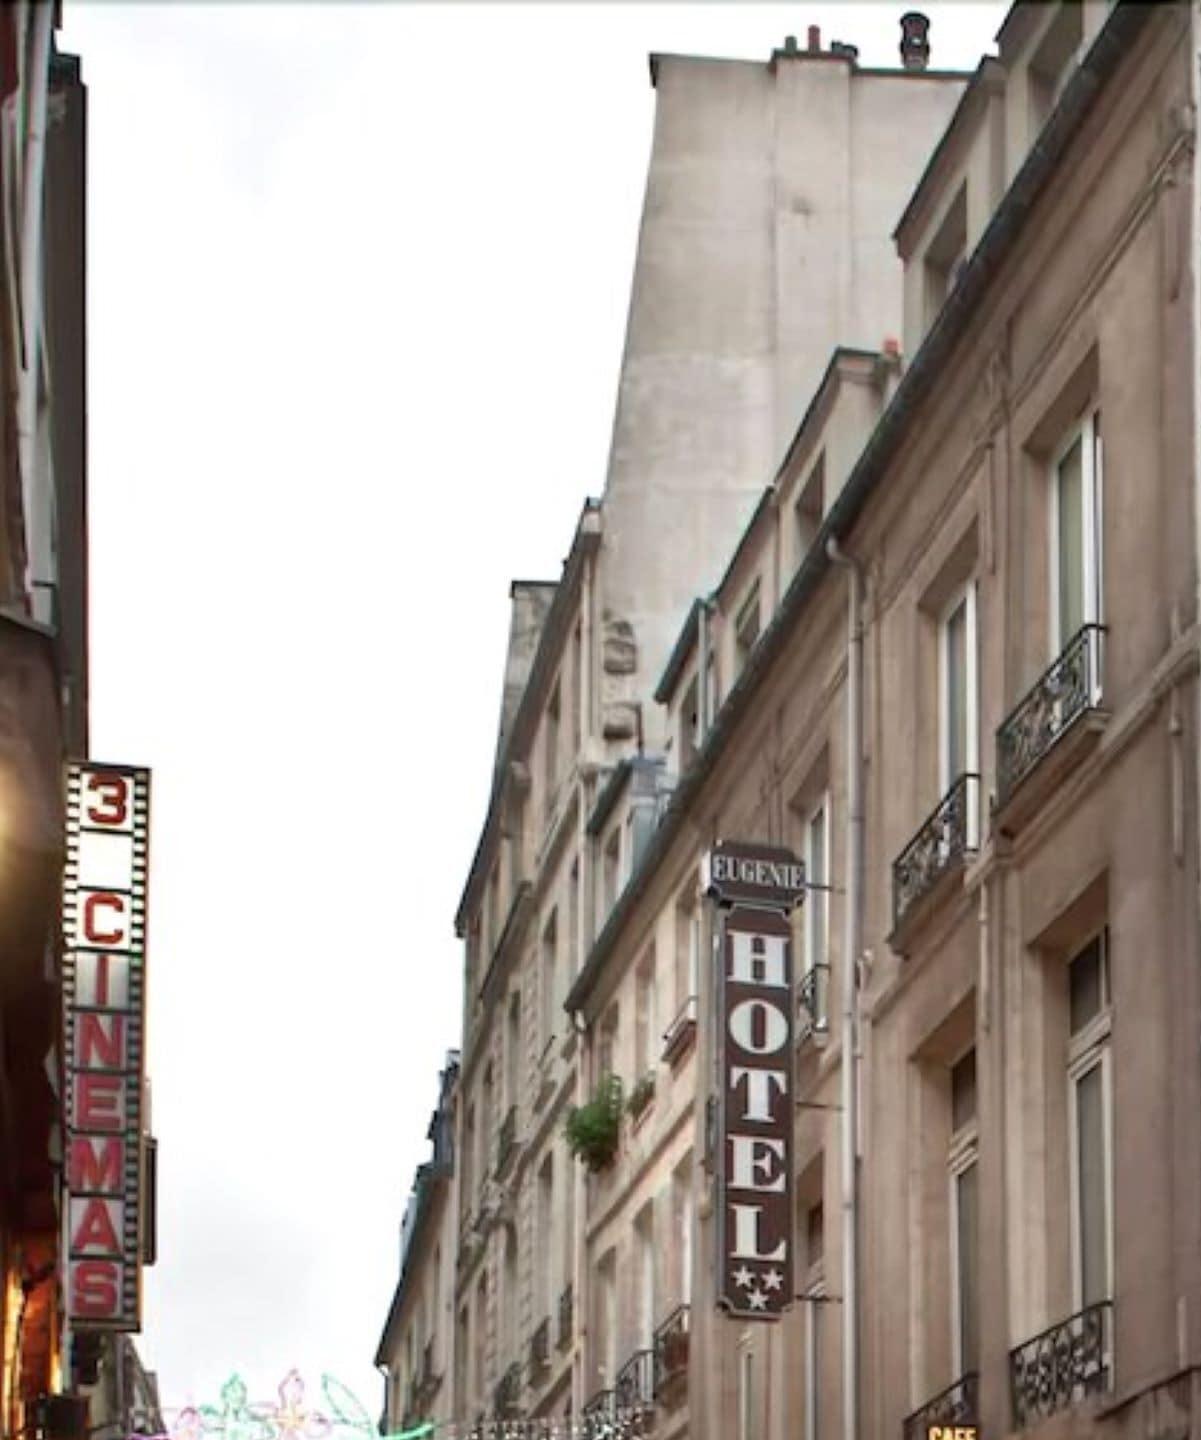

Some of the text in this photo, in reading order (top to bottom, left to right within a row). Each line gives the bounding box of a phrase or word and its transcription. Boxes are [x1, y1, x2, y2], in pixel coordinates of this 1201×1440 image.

[712, 854, 805, 889] EUGENIE
[71, 772, 127, 1314] 3 CINEMAS
[727, 930, 789, 1262] HOTEL
